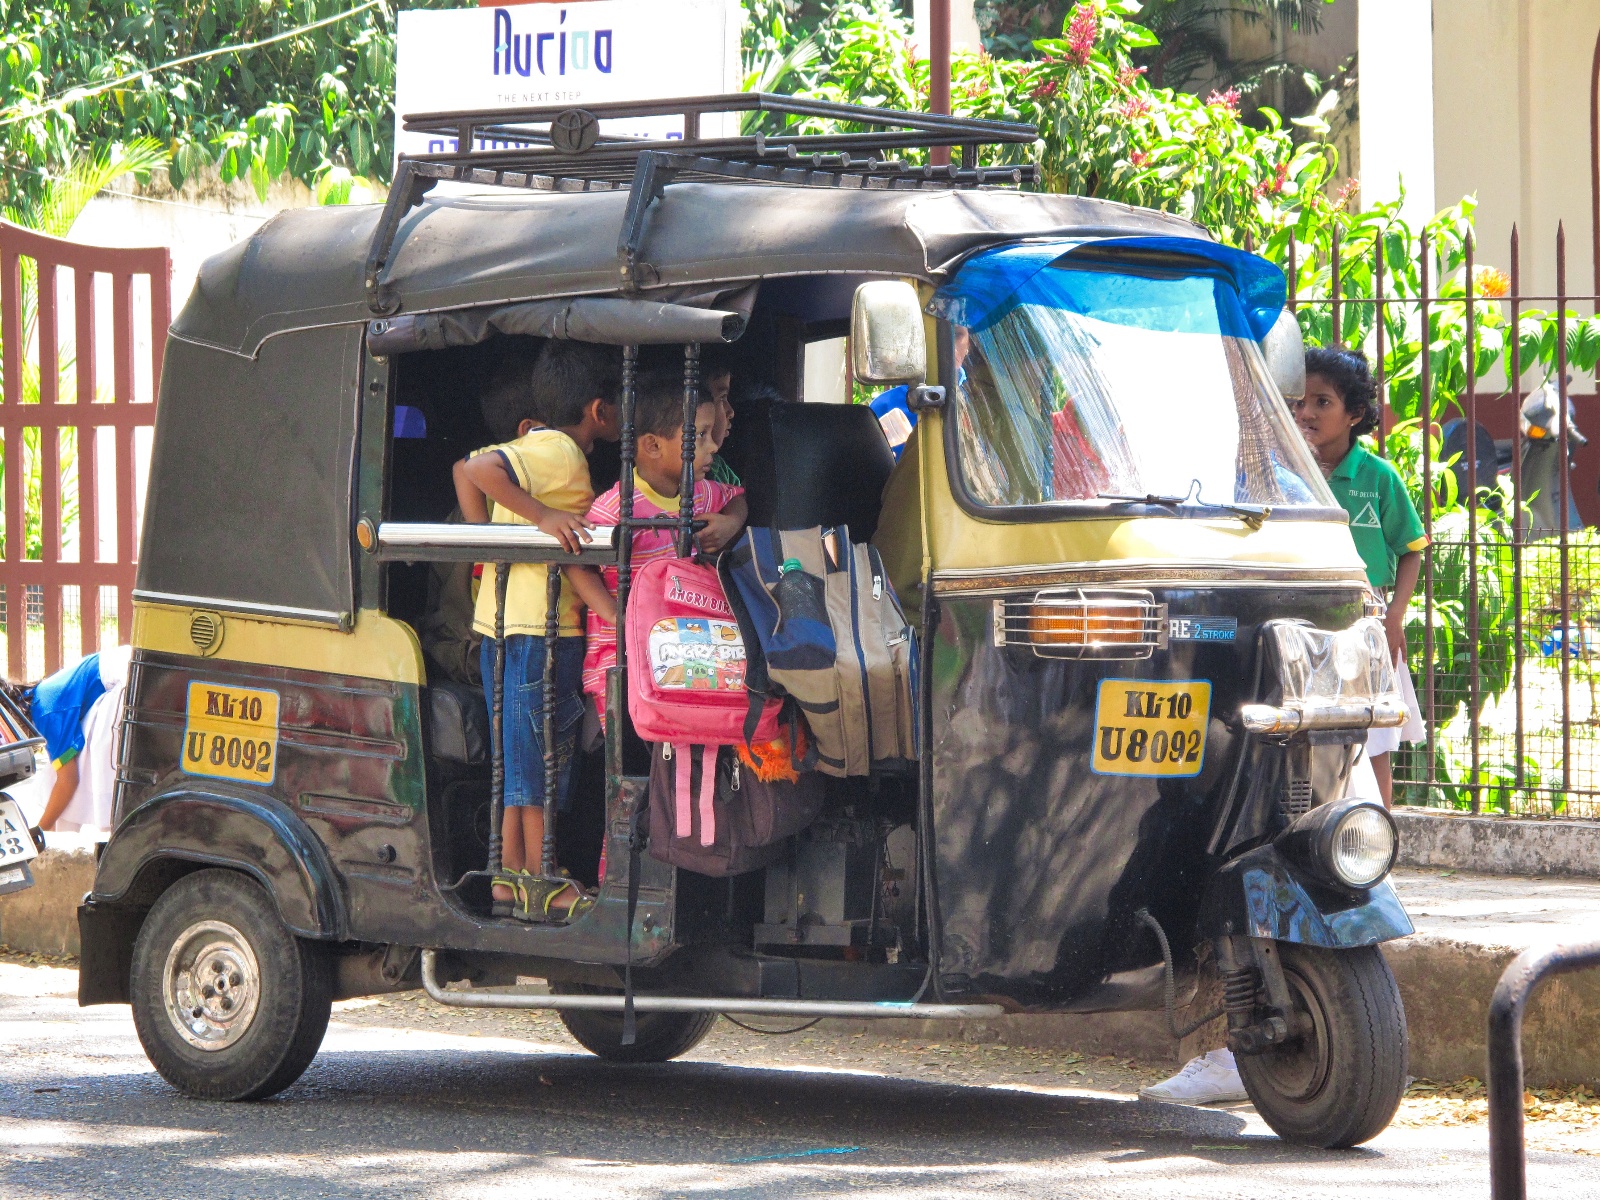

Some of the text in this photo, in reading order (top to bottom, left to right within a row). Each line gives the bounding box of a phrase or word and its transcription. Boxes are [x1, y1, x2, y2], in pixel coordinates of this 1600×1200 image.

[498, 91, 582, 103] THE NEXT STEP
[668, 587, 734, 615] ANGRY BIR
[1202, 630, 1236, 640] STROKE
[660, 642, 747, 662] ANGRY BIR
[187, 731, 272, 773] U 8092
[1100, 726, 1201, 763] U 8092
